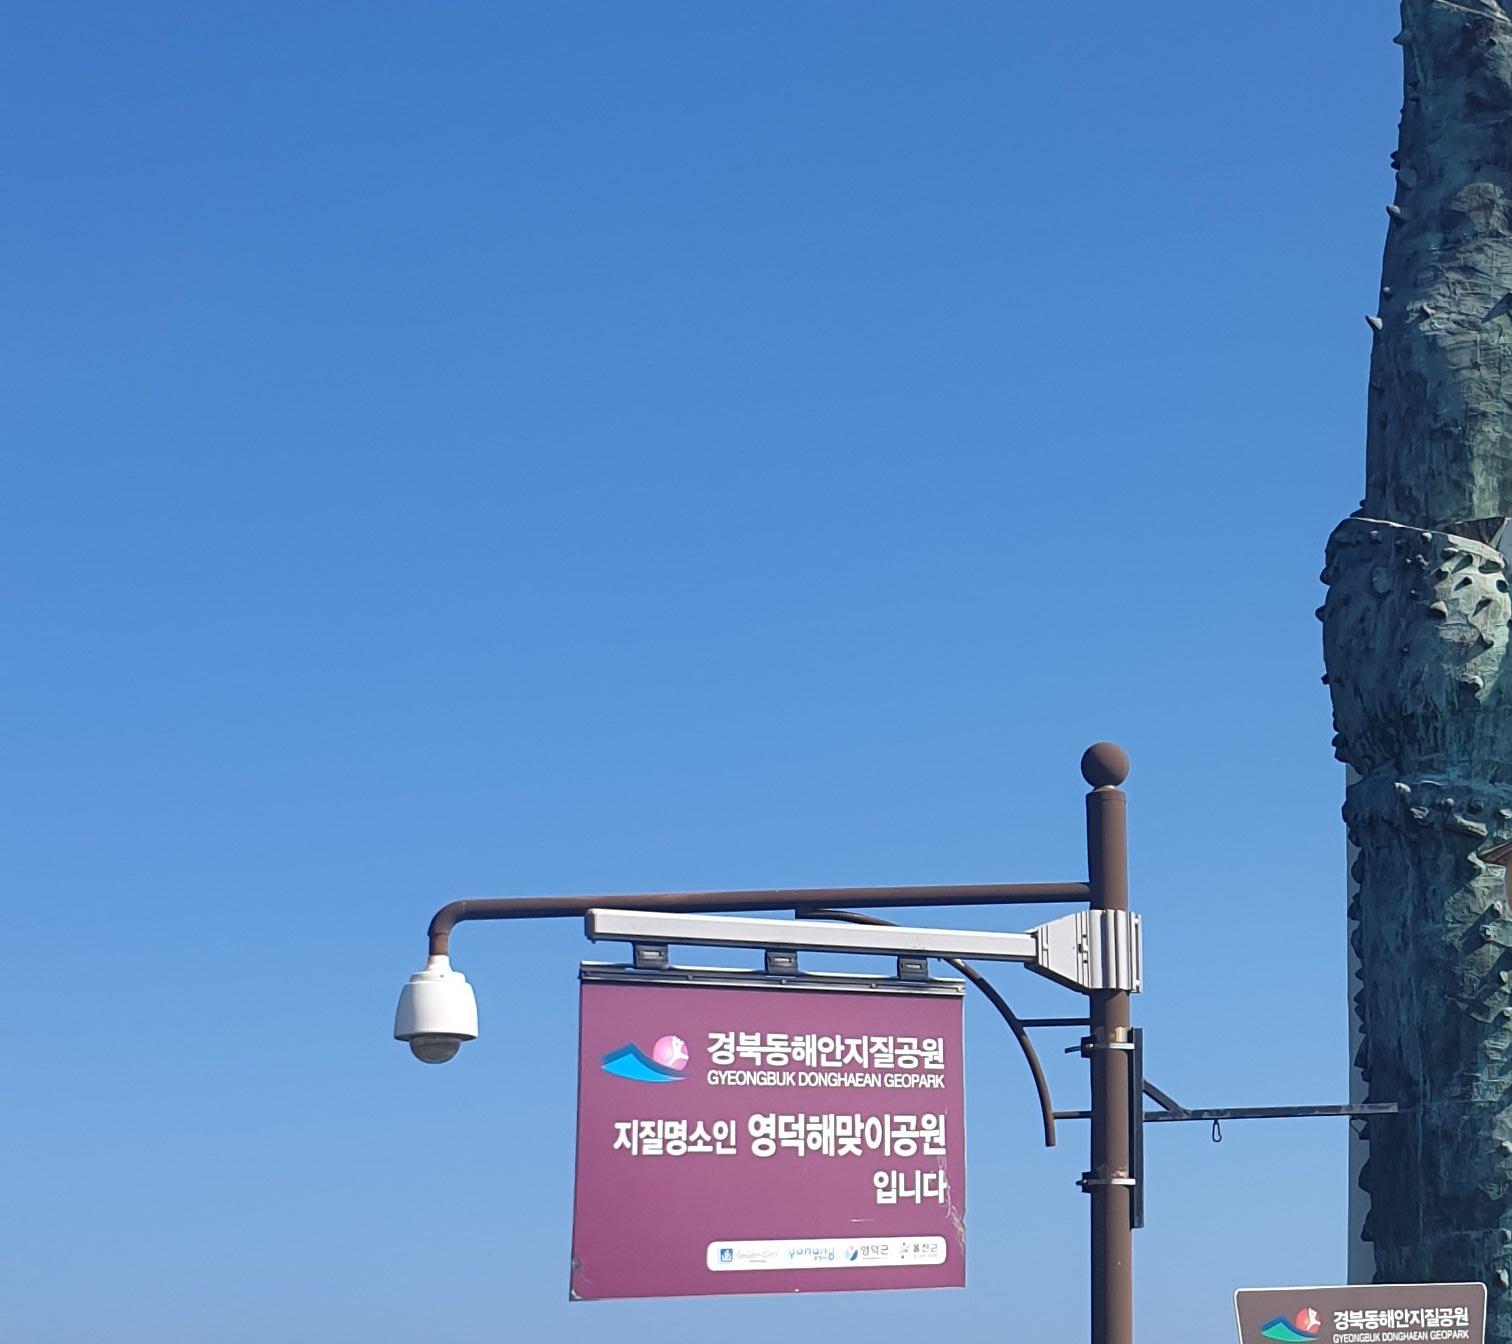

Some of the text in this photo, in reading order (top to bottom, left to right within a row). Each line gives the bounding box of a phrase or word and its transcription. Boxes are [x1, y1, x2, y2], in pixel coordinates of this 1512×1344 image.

[706, 1031, 946, 1069] 경북동해안지질공원
[707, 1069, 946, 1089] GYEONGBUK DONGHAEAN GEOPARK
[612, 1113, 947, 1157] 지질명소인 영덕해맞이공원
[872, 1169, 947, 1204] 입니다
[1333, 1306, 1470, 1331] 경북동해안지질공원
[1333, 1329, 1470, 1344] GYEONGBUK DONGHAEAN GEOPARK
